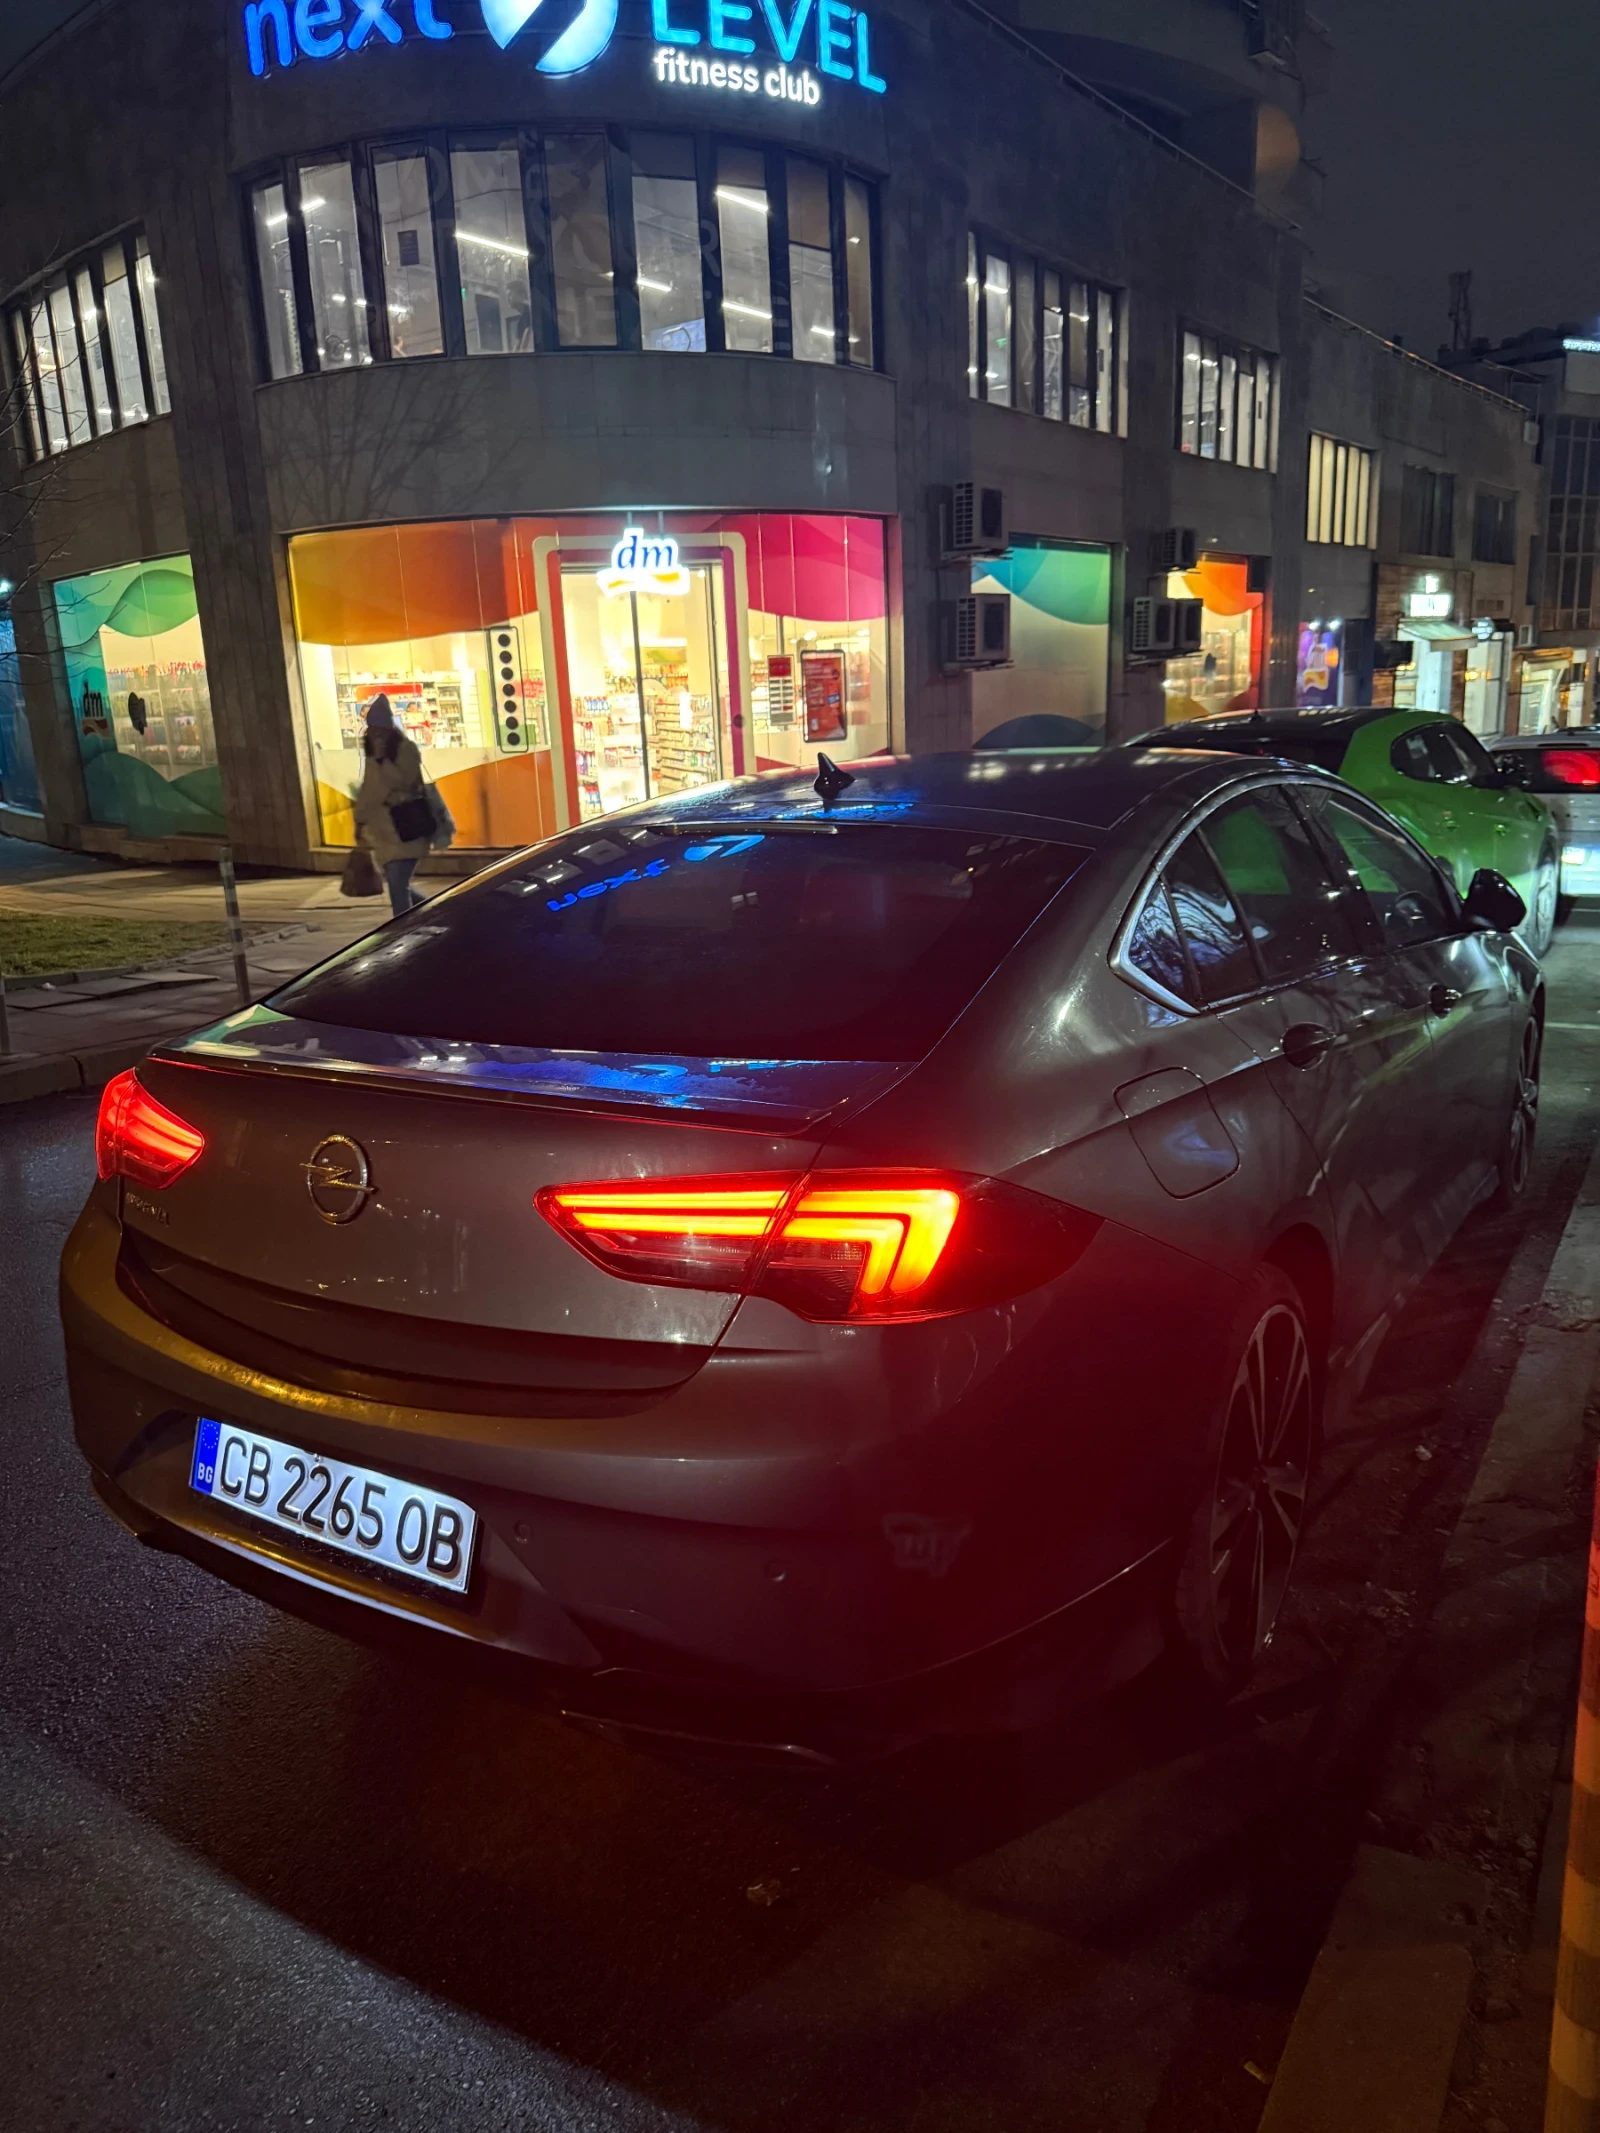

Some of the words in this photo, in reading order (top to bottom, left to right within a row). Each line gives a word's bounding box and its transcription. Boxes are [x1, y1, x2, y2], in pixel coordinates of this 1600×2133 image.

[653, 0, 887, 93] LEVEL
[653, 48, 759, 93] fitness
[764, 64, 820, 105] club
[617, 535, 673, 569] dm
[82, 680, 104, 718] dm
[197, 1462, 214, 1484] BG
[220, 1437, 272, 1505] CB
[277, 1457, 386, 1547] 2265
